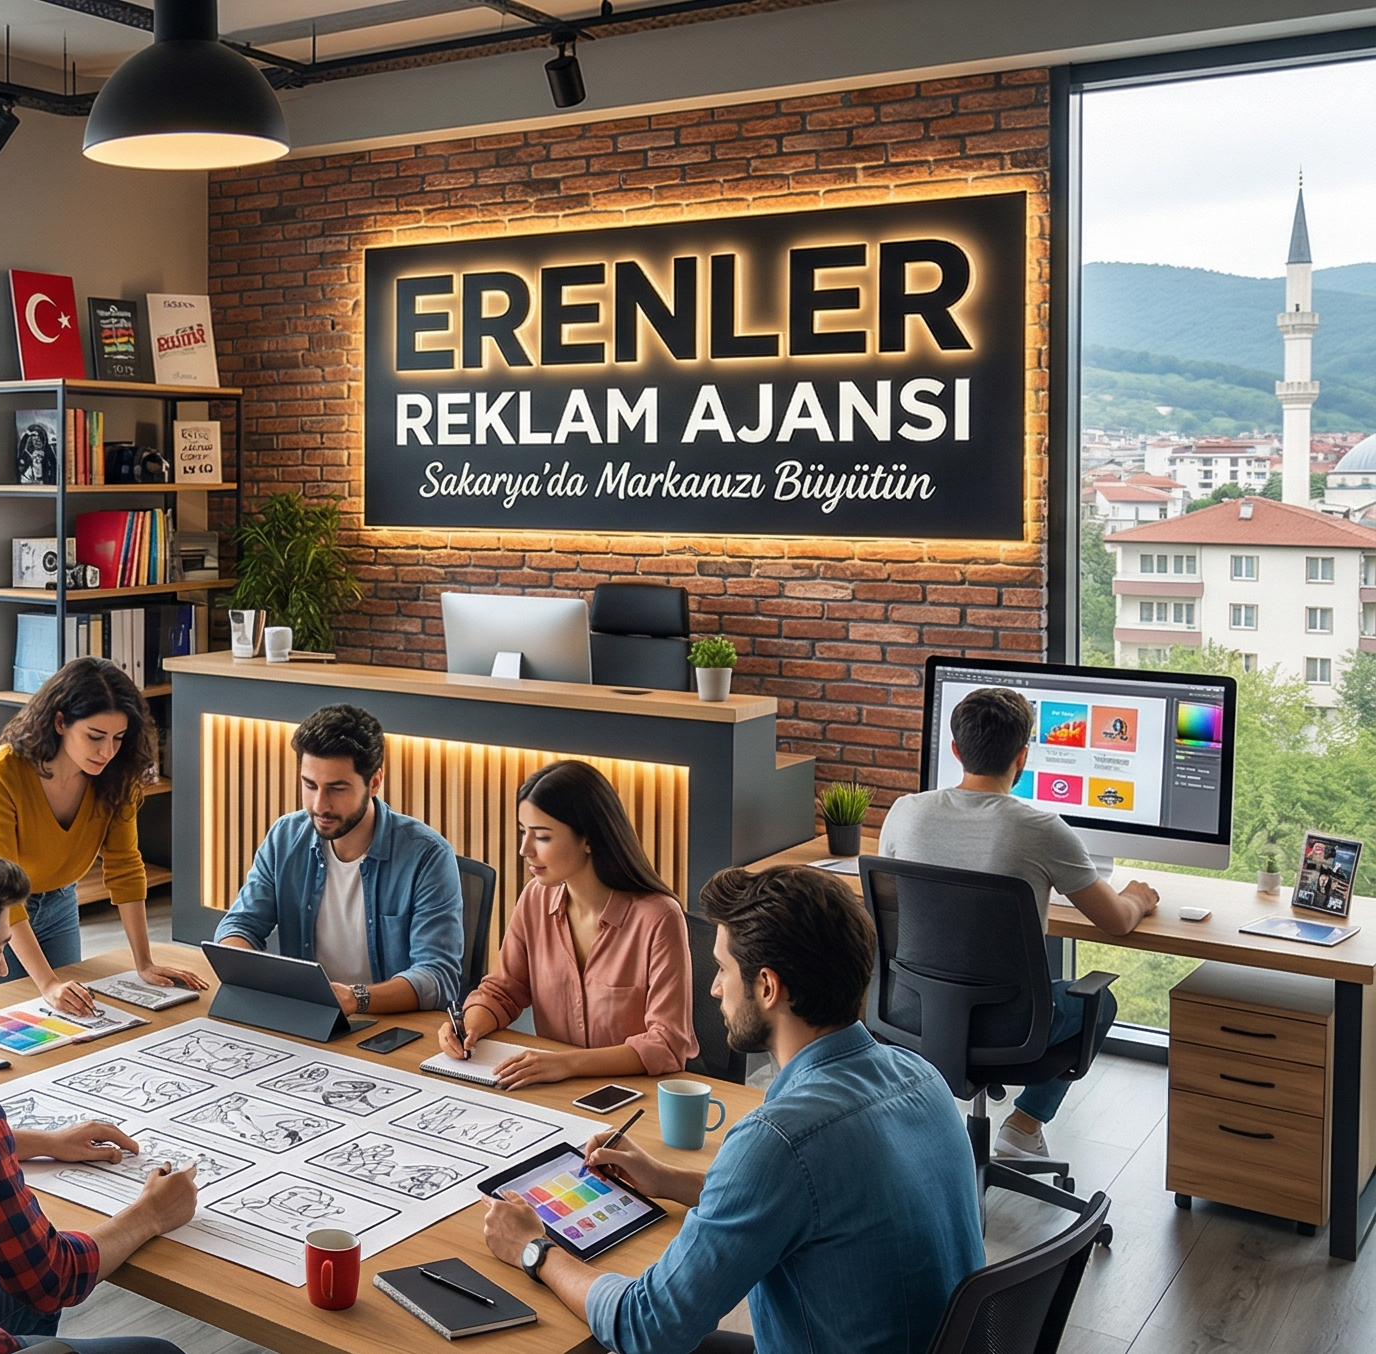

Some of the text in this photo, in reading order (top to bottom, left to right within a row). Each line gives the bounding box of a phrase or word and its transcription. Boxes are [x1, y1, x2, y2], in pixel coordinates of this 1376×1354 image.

[394, 239, 974, 372] ERENLER
[395, 377, 971, 446] REKLAM AJANSI
[418, 460, 937, 514] Sakarya'da Markanızı Büyütün
